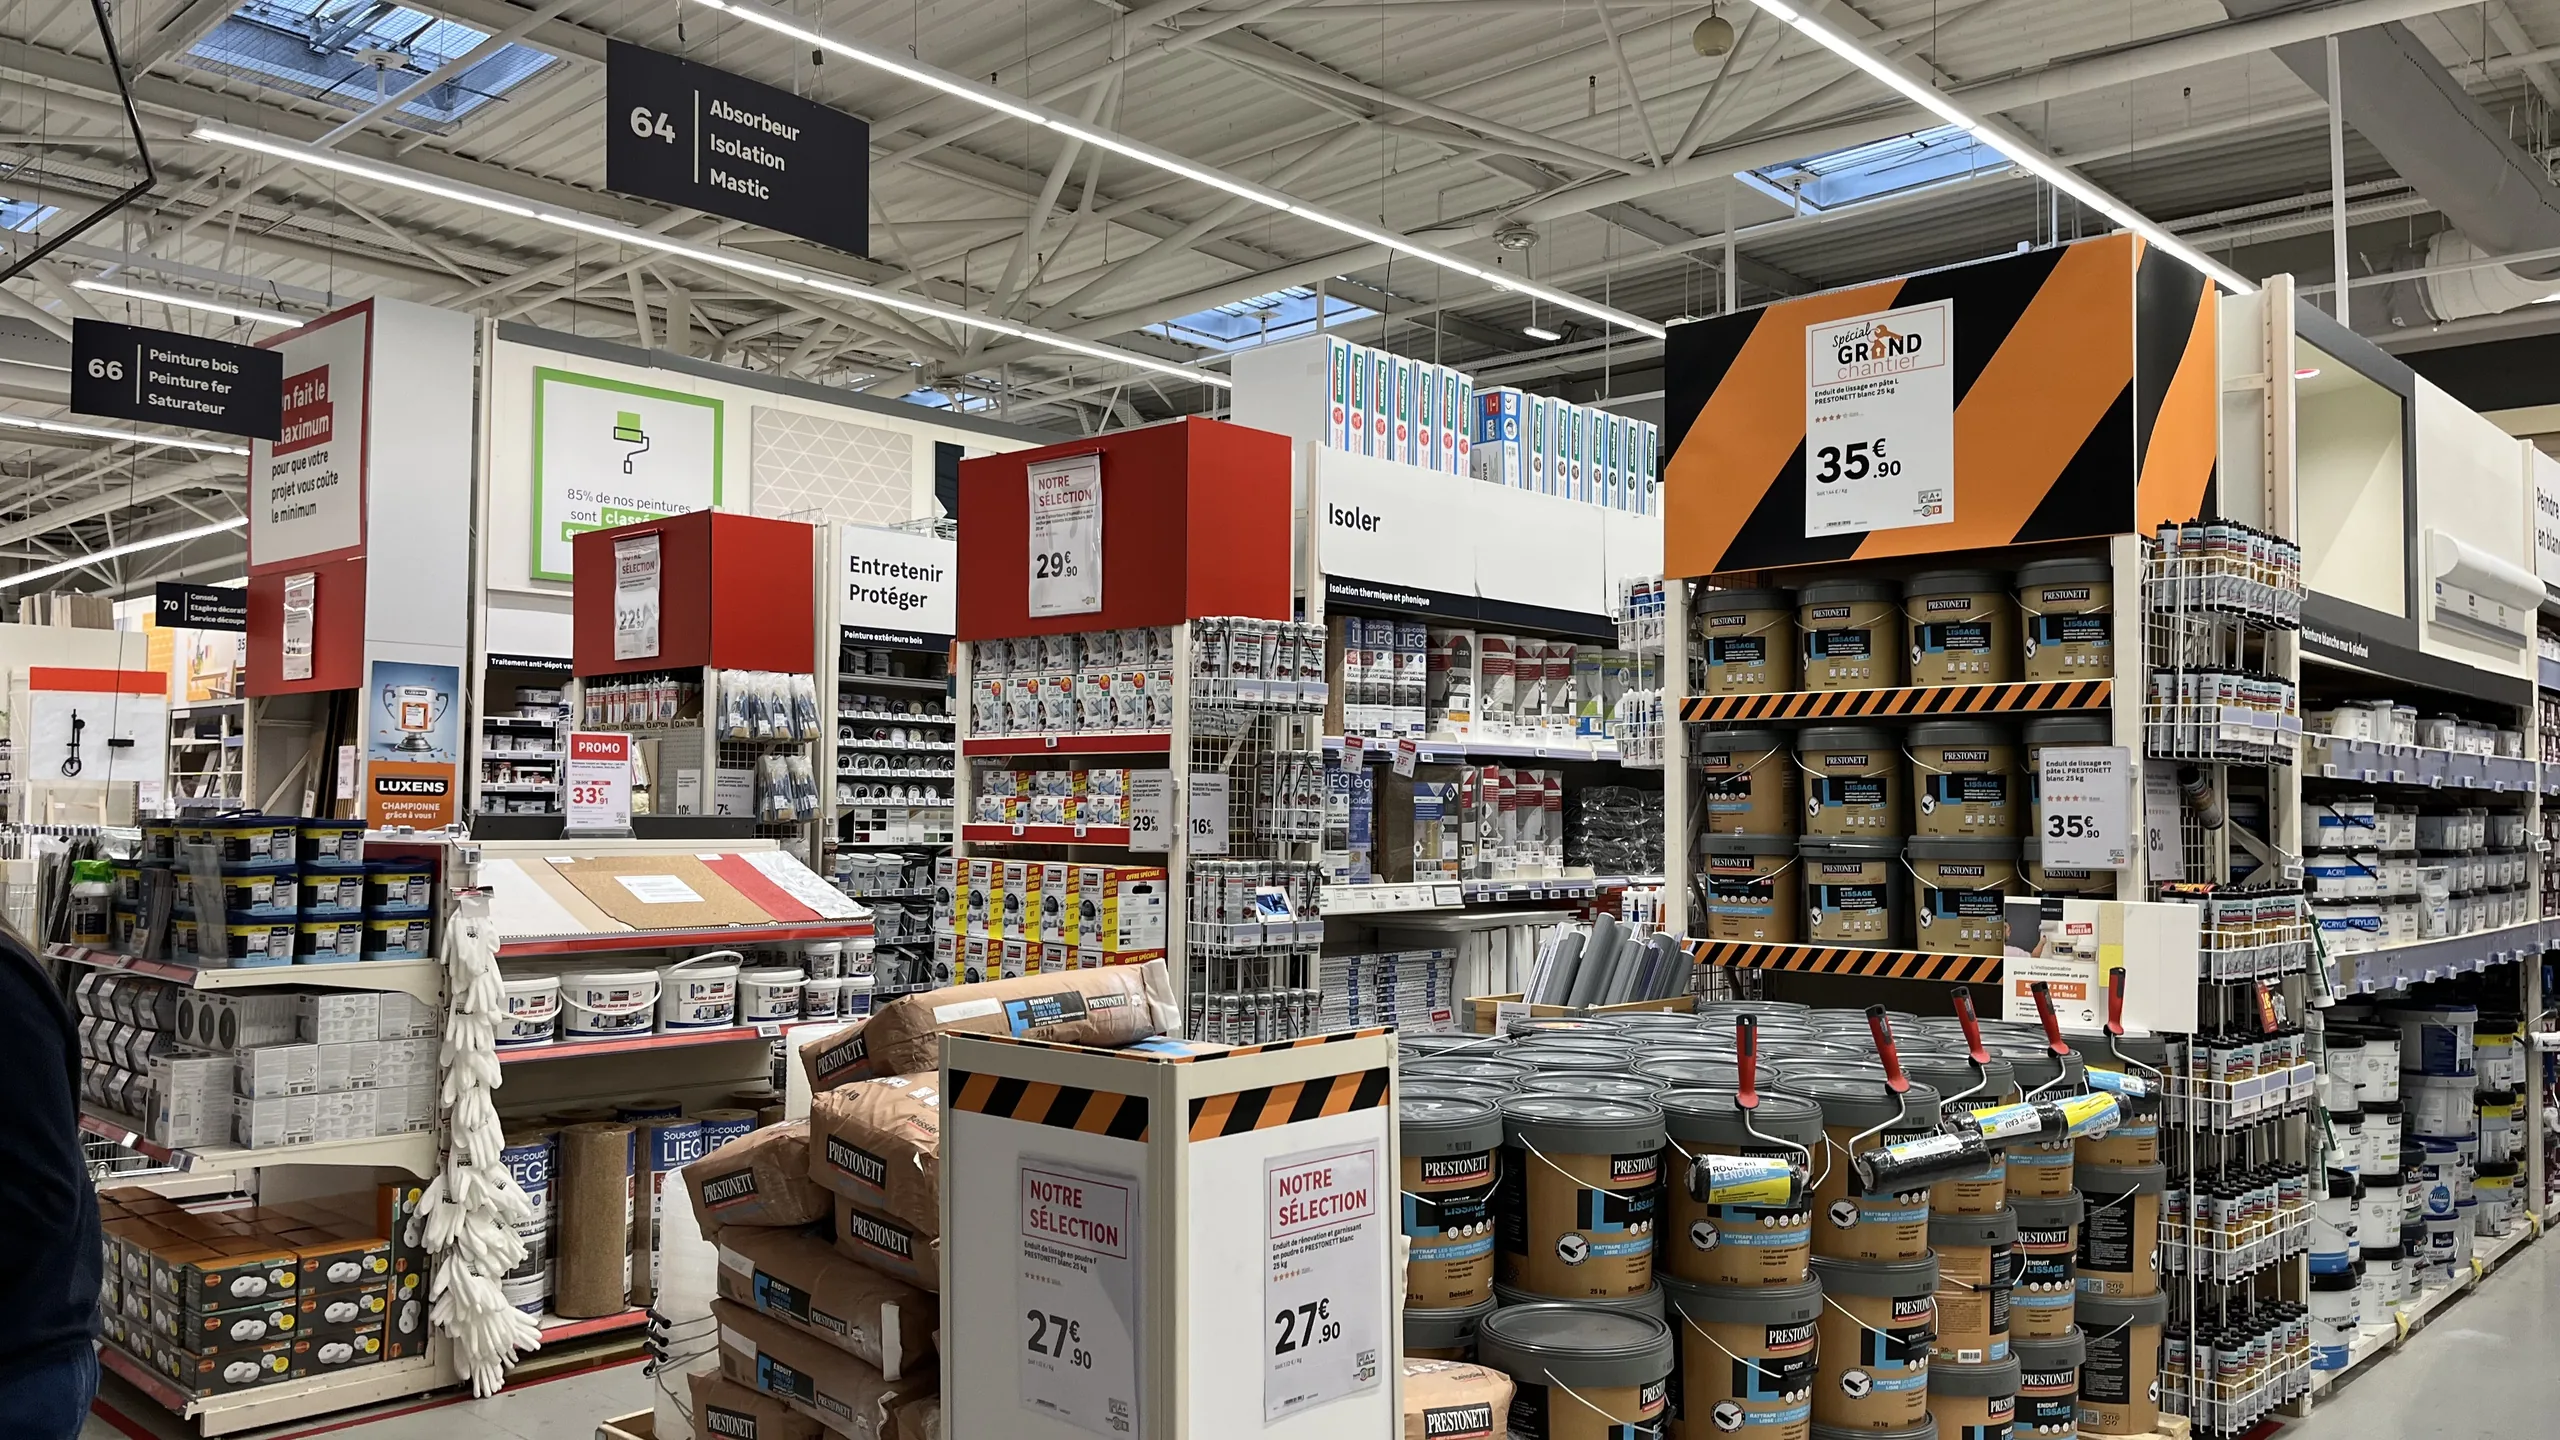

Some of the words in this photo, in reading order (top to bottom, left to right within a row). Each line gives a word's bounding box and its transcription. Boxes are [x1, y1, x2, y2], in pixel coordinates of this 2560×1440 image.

[630, 106, 676, 144] 64
[710, 99, 800, 141] Absorbeur
[710, 133, 785, 171] Isolation
[710, 168, 770, 200] Mastic
[1832, 321, 1871, 349] Spécial
[88, 358, 123, 381] 66
[149, 348, 210, 369] Peinture
[211, 357, 239, 375] bois
[1837, 354, 1920, 380] chantier
[149, 371, 209, 391] Peinture
[210, 379, 232, 395] fer
[1815, 388, 1835, 398] Enduit
[1837, 386, 1845, 394] de
[1846, 383, 1868, 395] lissage
[1879, 379, 1894, 389] pâte
[293, 382, 313, 408] fait
[315, 379, 326, 401] le
[1814, 393, 1857, 405] PRESTONETT
[1857, 389, 1876, 400] blanc
[1877, 388, 1886, 396] 25
[1886, 387, 1896, 396] kg
[148, 393, 225, 416] Saturateur
[272, 461, 291, 480] pour
[292, 458, 306, 475] que
[308, 451, 328, 466] votre
[272, 482, 295, 504] projet
[297, 478, 315, 495] vous
[317, 470, 338, 489] coûte
[1039, 475, 1070, 490] NOTRE
[567, 488, 594, 502] 85%
[595, 492, 610, 505] de
[613, 495, 634, 507] nos
[637, 496, 691, 514] peintures
[1040, 489, 1092, 507] SÉLECTION
[2537, 487, 2559, 519] Peindre
[272, 509, 279, 523] le
[280, 502, 316, 522] minimum
[570, 509, 597, 523] sont
[1329, 503, 1380, 532] Isoler
[2538, 529, 2545, 549] en
[622, 561, 656, 574] SÉLECTION
[850, 555, 943, 582] Entretenir
[191, 593, 218, 602] Console
[850, 583, 928, 611] Protéger
[1330, 584, 1358, 596] Isolation
[1360, 588, 1393, 601] thermique
[1401, 594, 1430, 606] phonique
[2044, 590, 2089, 600] PRESTONETT
[163, 600, 178, 611] 70
[191, 604, 217, 613] Etagère
[1813, 608, 1850, 619] PRESTONETT
[1928, 600, 1970, 610] PRESTONETT
[191, 615, 216, 624] Service
[217, 616, 245, 625] découpe
[1711, 616, 1745, 627] PRESTONETT
[2063, 620, 2101, 628] LISSAGE
[844, 630, 873, 640] Peinture
[874, 633, 909, 644] extérieure
[909, 636, 923, 645] bois
[1946, 628, 1981, 636] LISSAGE
[2302, 626, 2321, 644] Peinture
[2322, 632, 2339, 649] blanche
[2340, 640, 2348, 652] mur
[2353, 642, 2369, 659] plafond
[491, 658, 528, 668] Traitement
[578, 741, 621, 754] PROMO
[1945, 752, 1987, 760] PRESTONETT
[1826, 755, 1867, 765] PRESTONETT
[2078, 760, 2102, 768] lissage
[2046, 767, 2061, 775] pâte
[379, 780, 445, 793] LUXENS
[382, 802, 440, 811] CHAMPIONNE
[385, 811, 407, 820] grâce
[1712, 857, 1751, 868] PRESTONETT
[1823, 864, 1860, 874] PRESTONETT
[1940, 866, 1983, 876] PRESTONETT
[1140, 870, 1159, 878] SPÉCIALE
[2031, 964, 2072, 972] L'indispensable
[1029, 997, 1055, 1005] ENDUIT
[1089, 996, 1125, 1010] PRESTONETT
[816, 1039, 864, 1077] PRESTONETT
[829, 1141, 884, 1183] PRESTONETT
[1425, 1155, 1489, 1177] PRESTONETT
[1280, 1168, 1332, 1198] NOTRE
[1724, 1168, 1768, 1180] ENDUIRE
[703, 1173, 753, 1203] PRESTONETT
[1030, 1179, 1083, 1209] NOTRE
[1279, 1189, 1367, 1227] SÉLECTION
[853, 1214, 909, 1255] PRESTONETT
[1030, 1206, 1118, 1247] SÉLECTION
[1273, 1240, 1290, 1251] Enduit
[1291, 1238, 1298, 1246] de
[1299, 1231, 1327, 1246] rénovation
[1334, 1223, 1362, 1238] garnissant
[1025, 1241, 1040, 1251] Enduit
[1041, 1245, 1048, 1253] de
[1049, 1245, 1066, 1258] lissage
[1075, 1252, 1093, 1264] poudre
[1273, 1253, 1280, 1261] en
[1281, 1248, 1299, 1263] poudre
[1305, 1237, 1339, 1252] PRESTONETT
[1339, 1234, 1354, 1245] blanc
[1025, 1250, 1056, 1265] PRESTONETT
[1058, 1258, 1072, 1268] blanc
[1273, 1262, 1280, 1270] 25
[1281, 1260, 1288, 1270] kg
[2027, 1265, 2064, 1274] LISSAGE
[1449, 1288, 1474, 1299] Beissier
[1783, 1361, 1803, 1372] ENDUIT
[2022, 1371, 2073, 1386] PRESTONETT
[1427, 1408, 1490, 1433] PRESTONETT
[2037, 1406, 2071, 1417] LISSAGE
